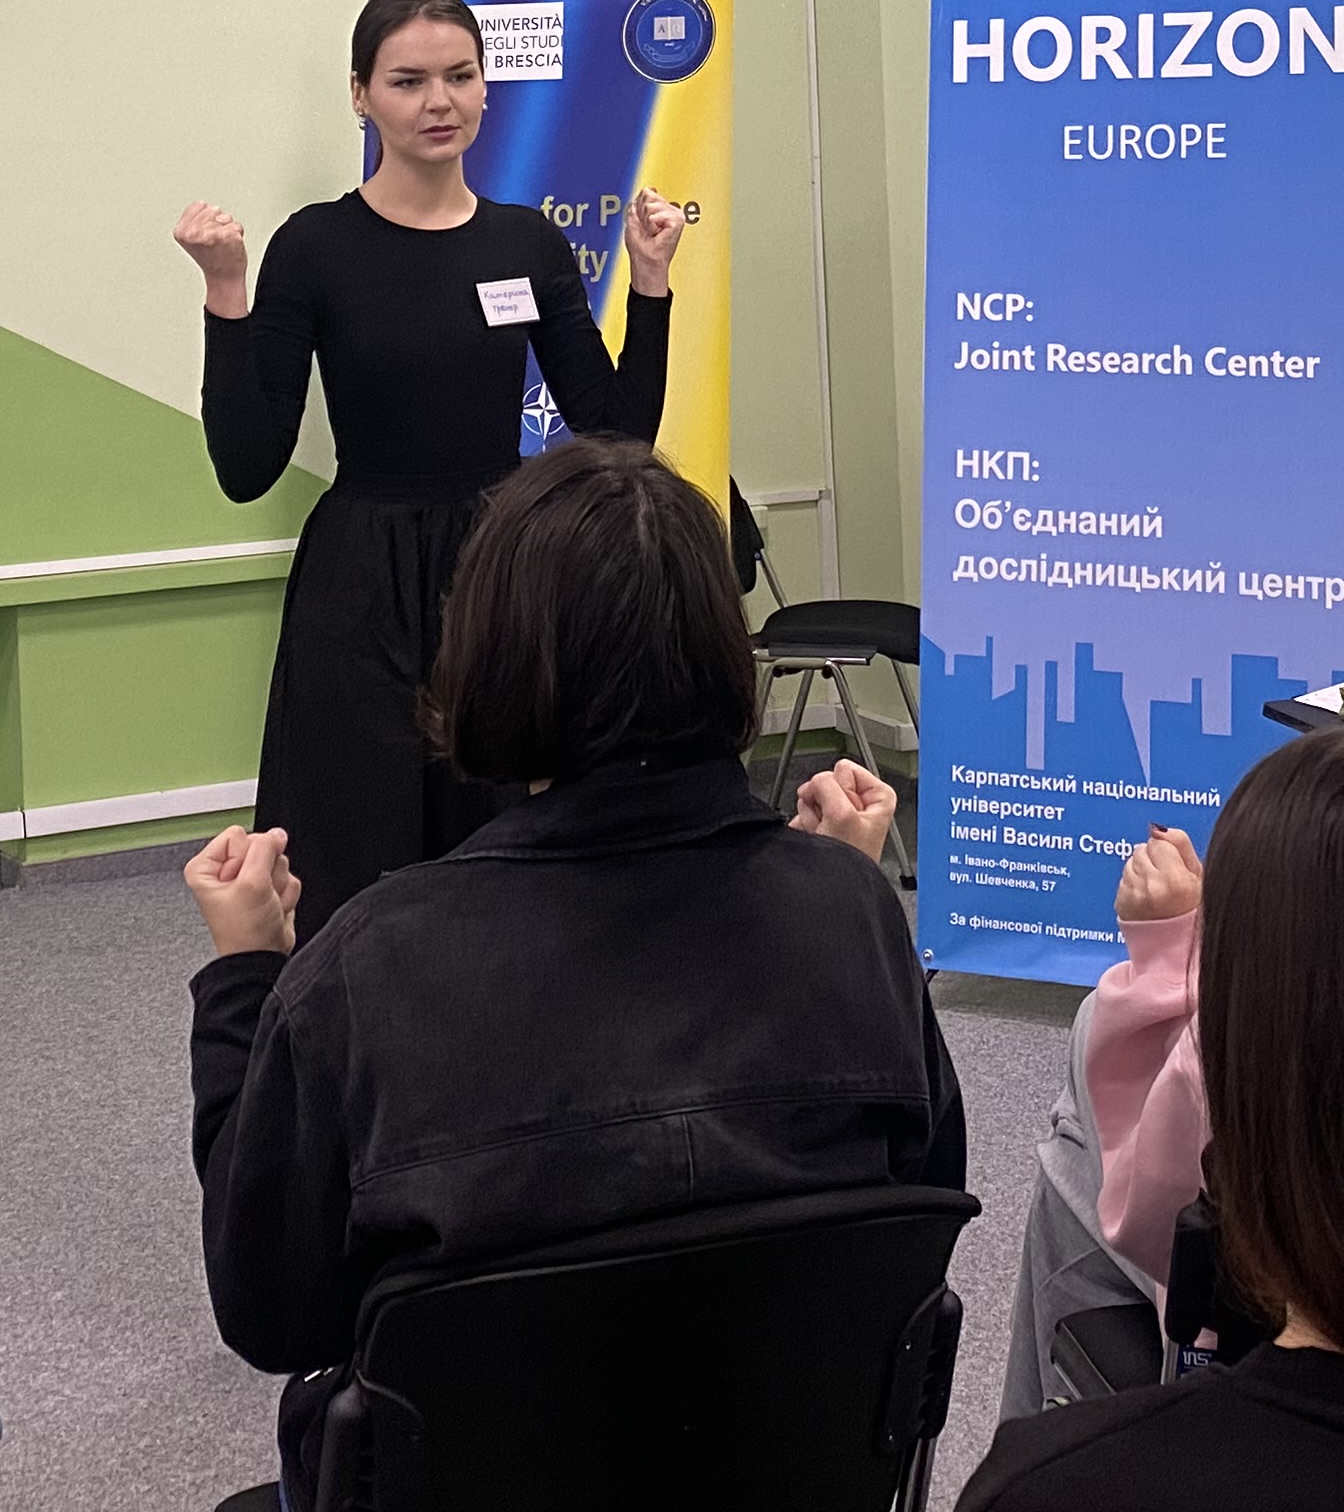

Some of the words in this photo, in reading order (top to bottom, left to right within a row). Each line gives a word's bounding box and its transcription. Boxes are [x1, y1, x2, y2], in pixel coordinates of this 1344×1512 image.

[495, 54, 563, 68] BRESCIA
[1063, 123, 1227, 160] EUROPE
[541, 196, 589, 228] for
[956, 292, 1034, 322] NCP:
[953, 341, 1036, 371] Joint
[1047, 343, 1193, 375] Research
[1204, 346, 1321, 379] Center
[956, 449, 1040, 482] НКП:
[952, 552, 1226, 594] дослідницький
[951, 764, 1077, 793] Карпатський
[1082, 778, 1221, 807] національний
[950, 795, 1065, 820] університет
[950, 822, 997, 844] імені
[1003, 827, 1073, 851] Василя
[1079, 833, 1133, 861] Стеф
[949, 872, 972, 884] вул.
[1041, 880, 1056, 892] 57
[949, 912, 966, 926] За
[969, 914, 1043, 935] фінансової
[1045, 924, 1114, 943] підтримки
